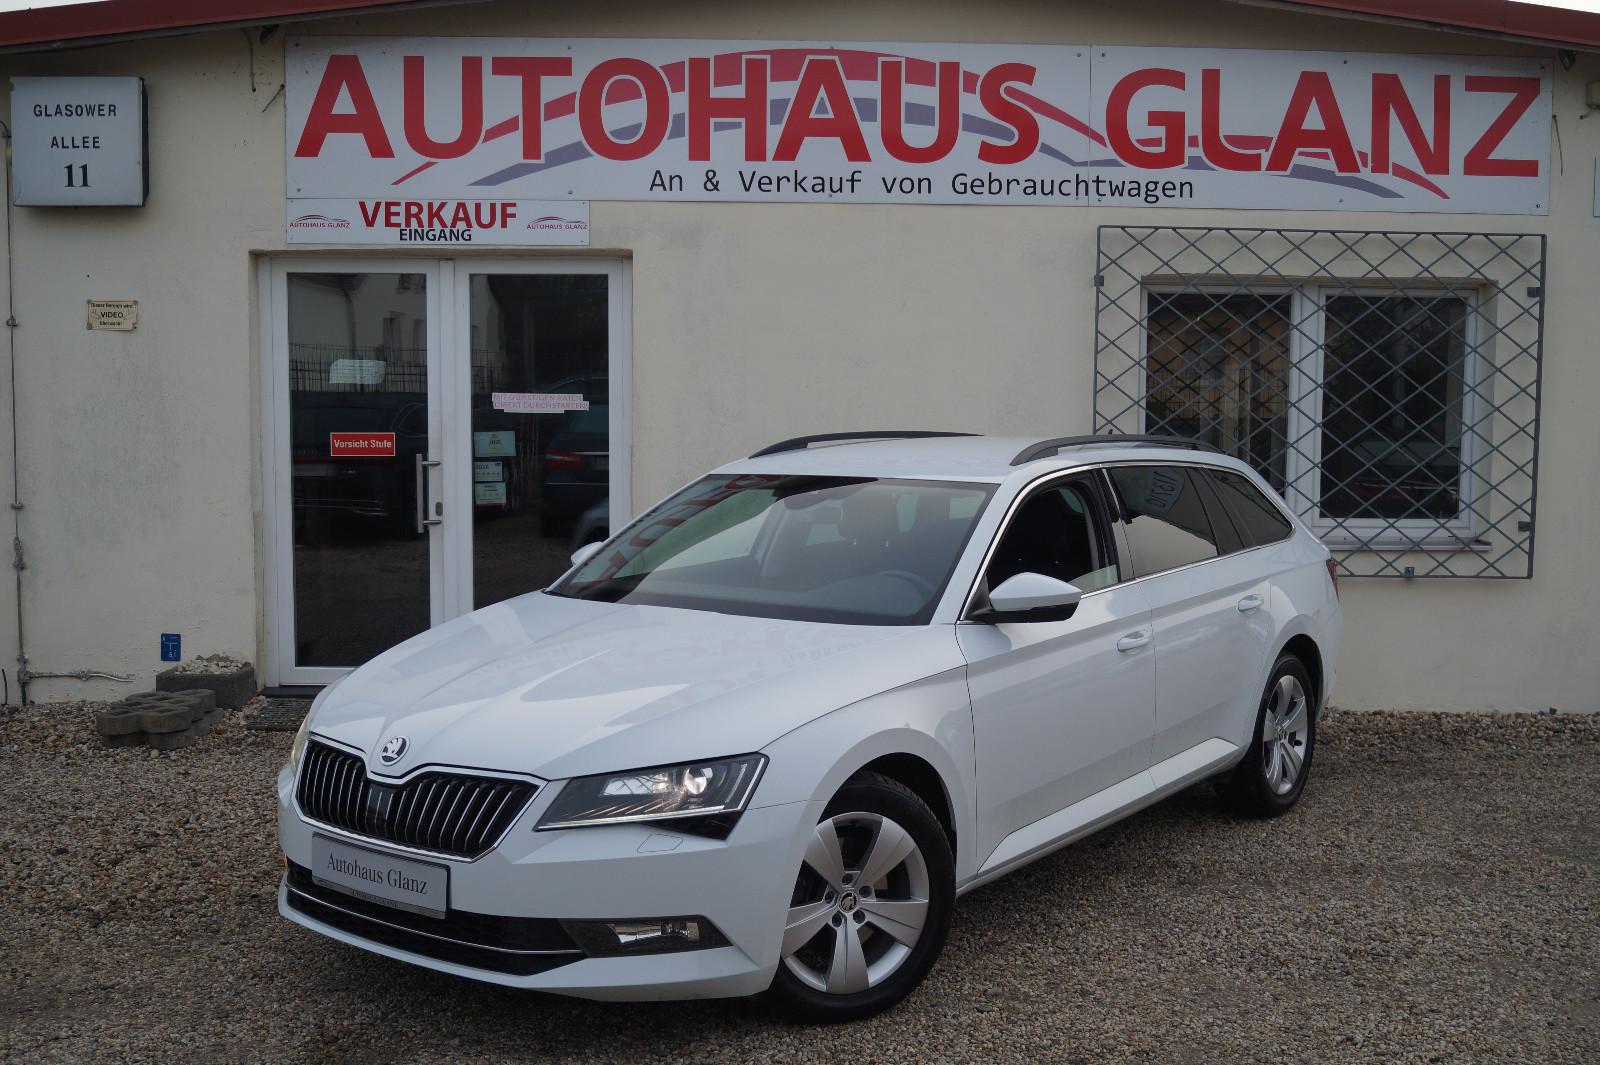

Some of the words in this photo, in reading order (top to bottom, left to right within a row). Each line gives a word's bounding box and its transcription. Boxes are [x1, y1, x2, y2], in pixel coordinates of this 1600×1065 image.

[33, 103, 117, 117] GLASOWER
[294, 53, 1040, 165] AUTOHAUS
[1105, 67, 1541, 177] GLANZ
[50, 135, 101, 149] ALLEE
[63, 163, 91, 188] 11
[649, 169, 683, 192] An
[703, 169, 721, 192] &
[738, 169, 862, 194] Verkauf
[881, 176, 932, 194] von
[951, 171, 1193, 205] Gebrauchtwagen
[358, 200, 517, 230] VERKAUF
[289, 221, 326, 229] AUTOHAUS
[526, 223, 562, 231] AUTOHAUS
[399, 228, 472, 242] EINGANG
[100, 311, 124, 319] VIDEO
[333, 439, 368, 449] Vorsicht
[370, 439, 392, 449] Stufe
[327, 852, 384, 885] Autohaus
[387, 868, 428, 896] Glanz
